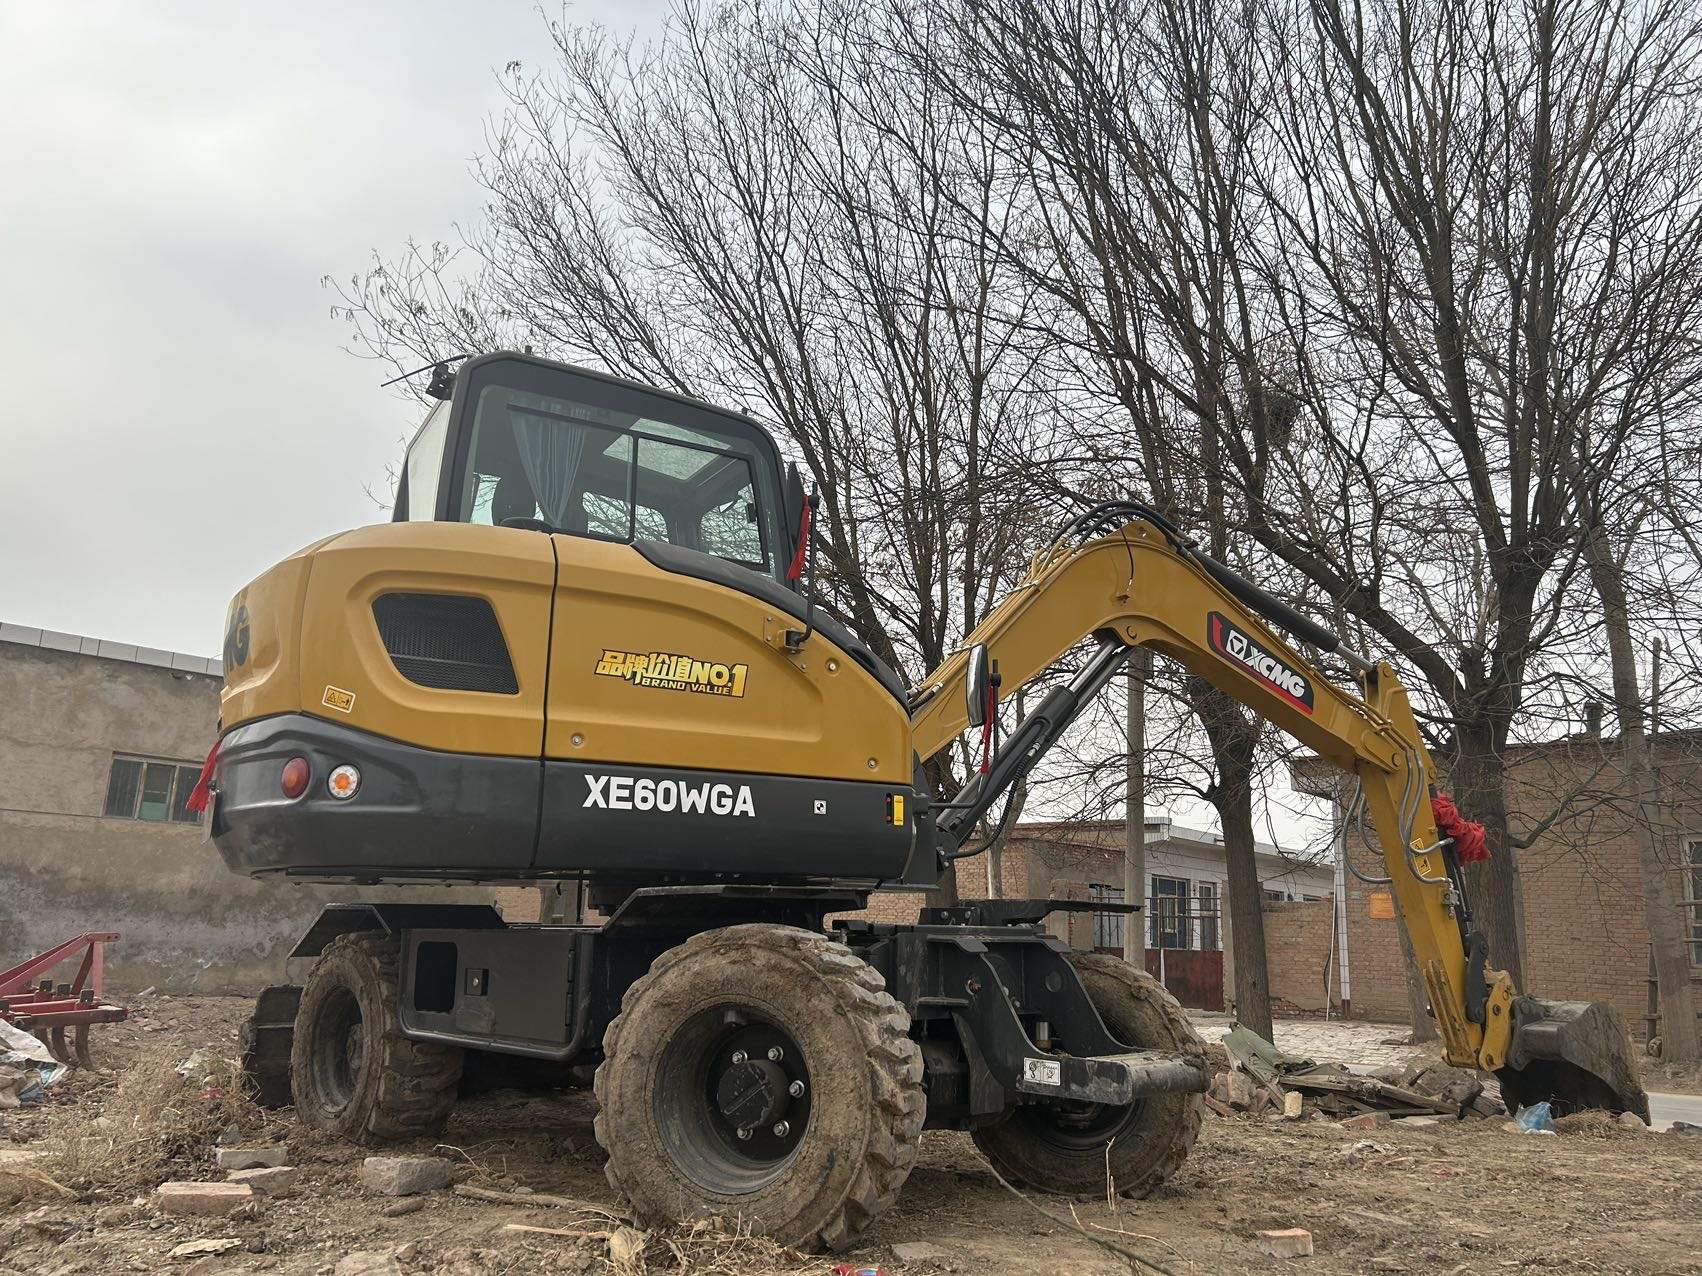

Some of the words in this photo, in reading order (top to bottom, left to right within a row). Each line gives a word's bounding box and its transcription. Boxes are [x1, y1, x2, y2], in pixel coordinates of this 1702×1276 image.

[641, 677, 686, 691] BRAND
[691, 683, 731, 695] VALUE
[1243, 646, 1305, 698] XCMG
[582, 774, 756, 817] XE60WGA
